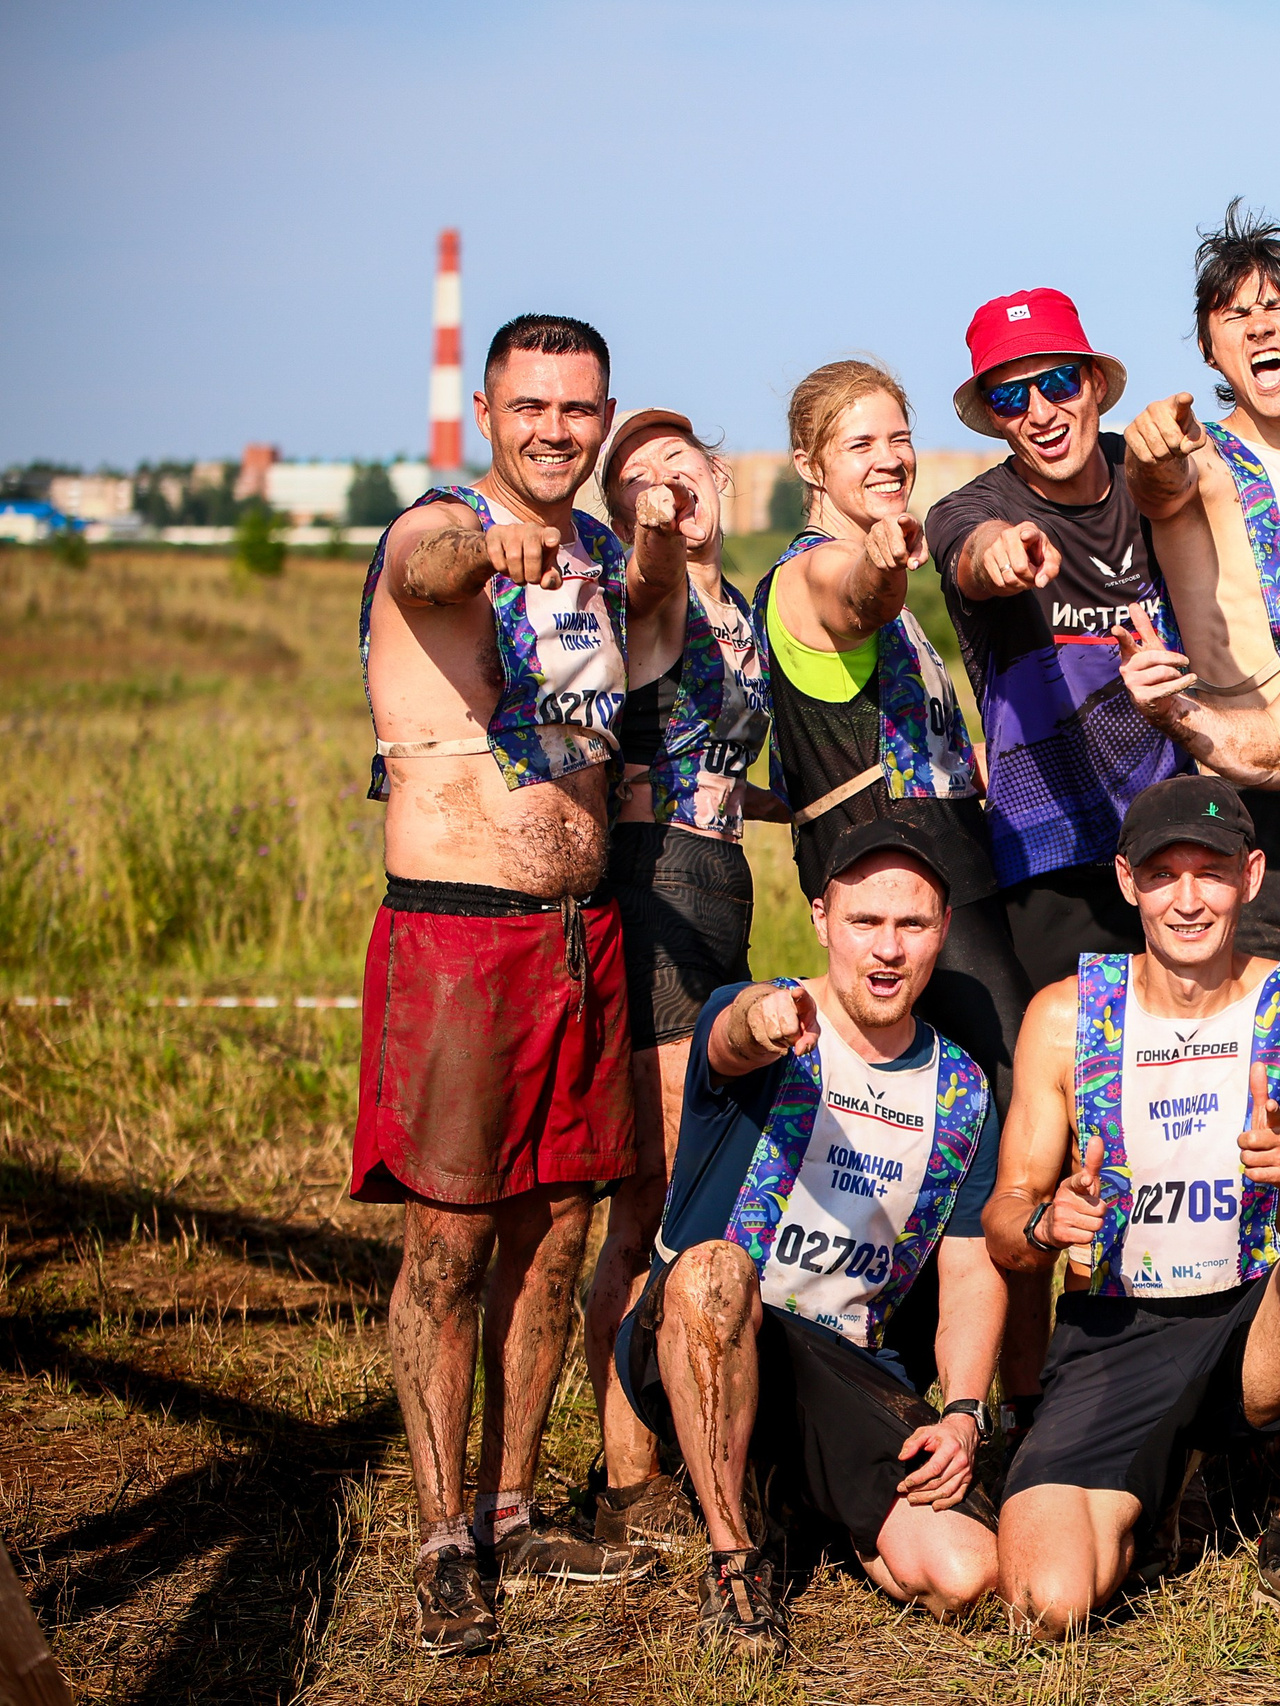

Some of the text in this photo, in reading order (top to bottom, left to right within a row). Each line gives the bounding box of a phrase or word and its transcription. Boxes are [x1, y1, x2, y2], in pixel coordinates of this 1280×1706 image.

[1136, 1041, 1239, 1062] ГОНКА ГЕРОЕВ
[827, 1090, 924, 1127] ГОНКА ГЕРОЕВ
[1149, 1093, 1219, 1120] КОМАНДА
[826, 1144, 904, 1183] КОМАНДА
[830, 1169, 889, 1198] 10КМ+
[1131, 1179, 1238, 1225] 02705
[775, 1223, 893, 1285] 02703
